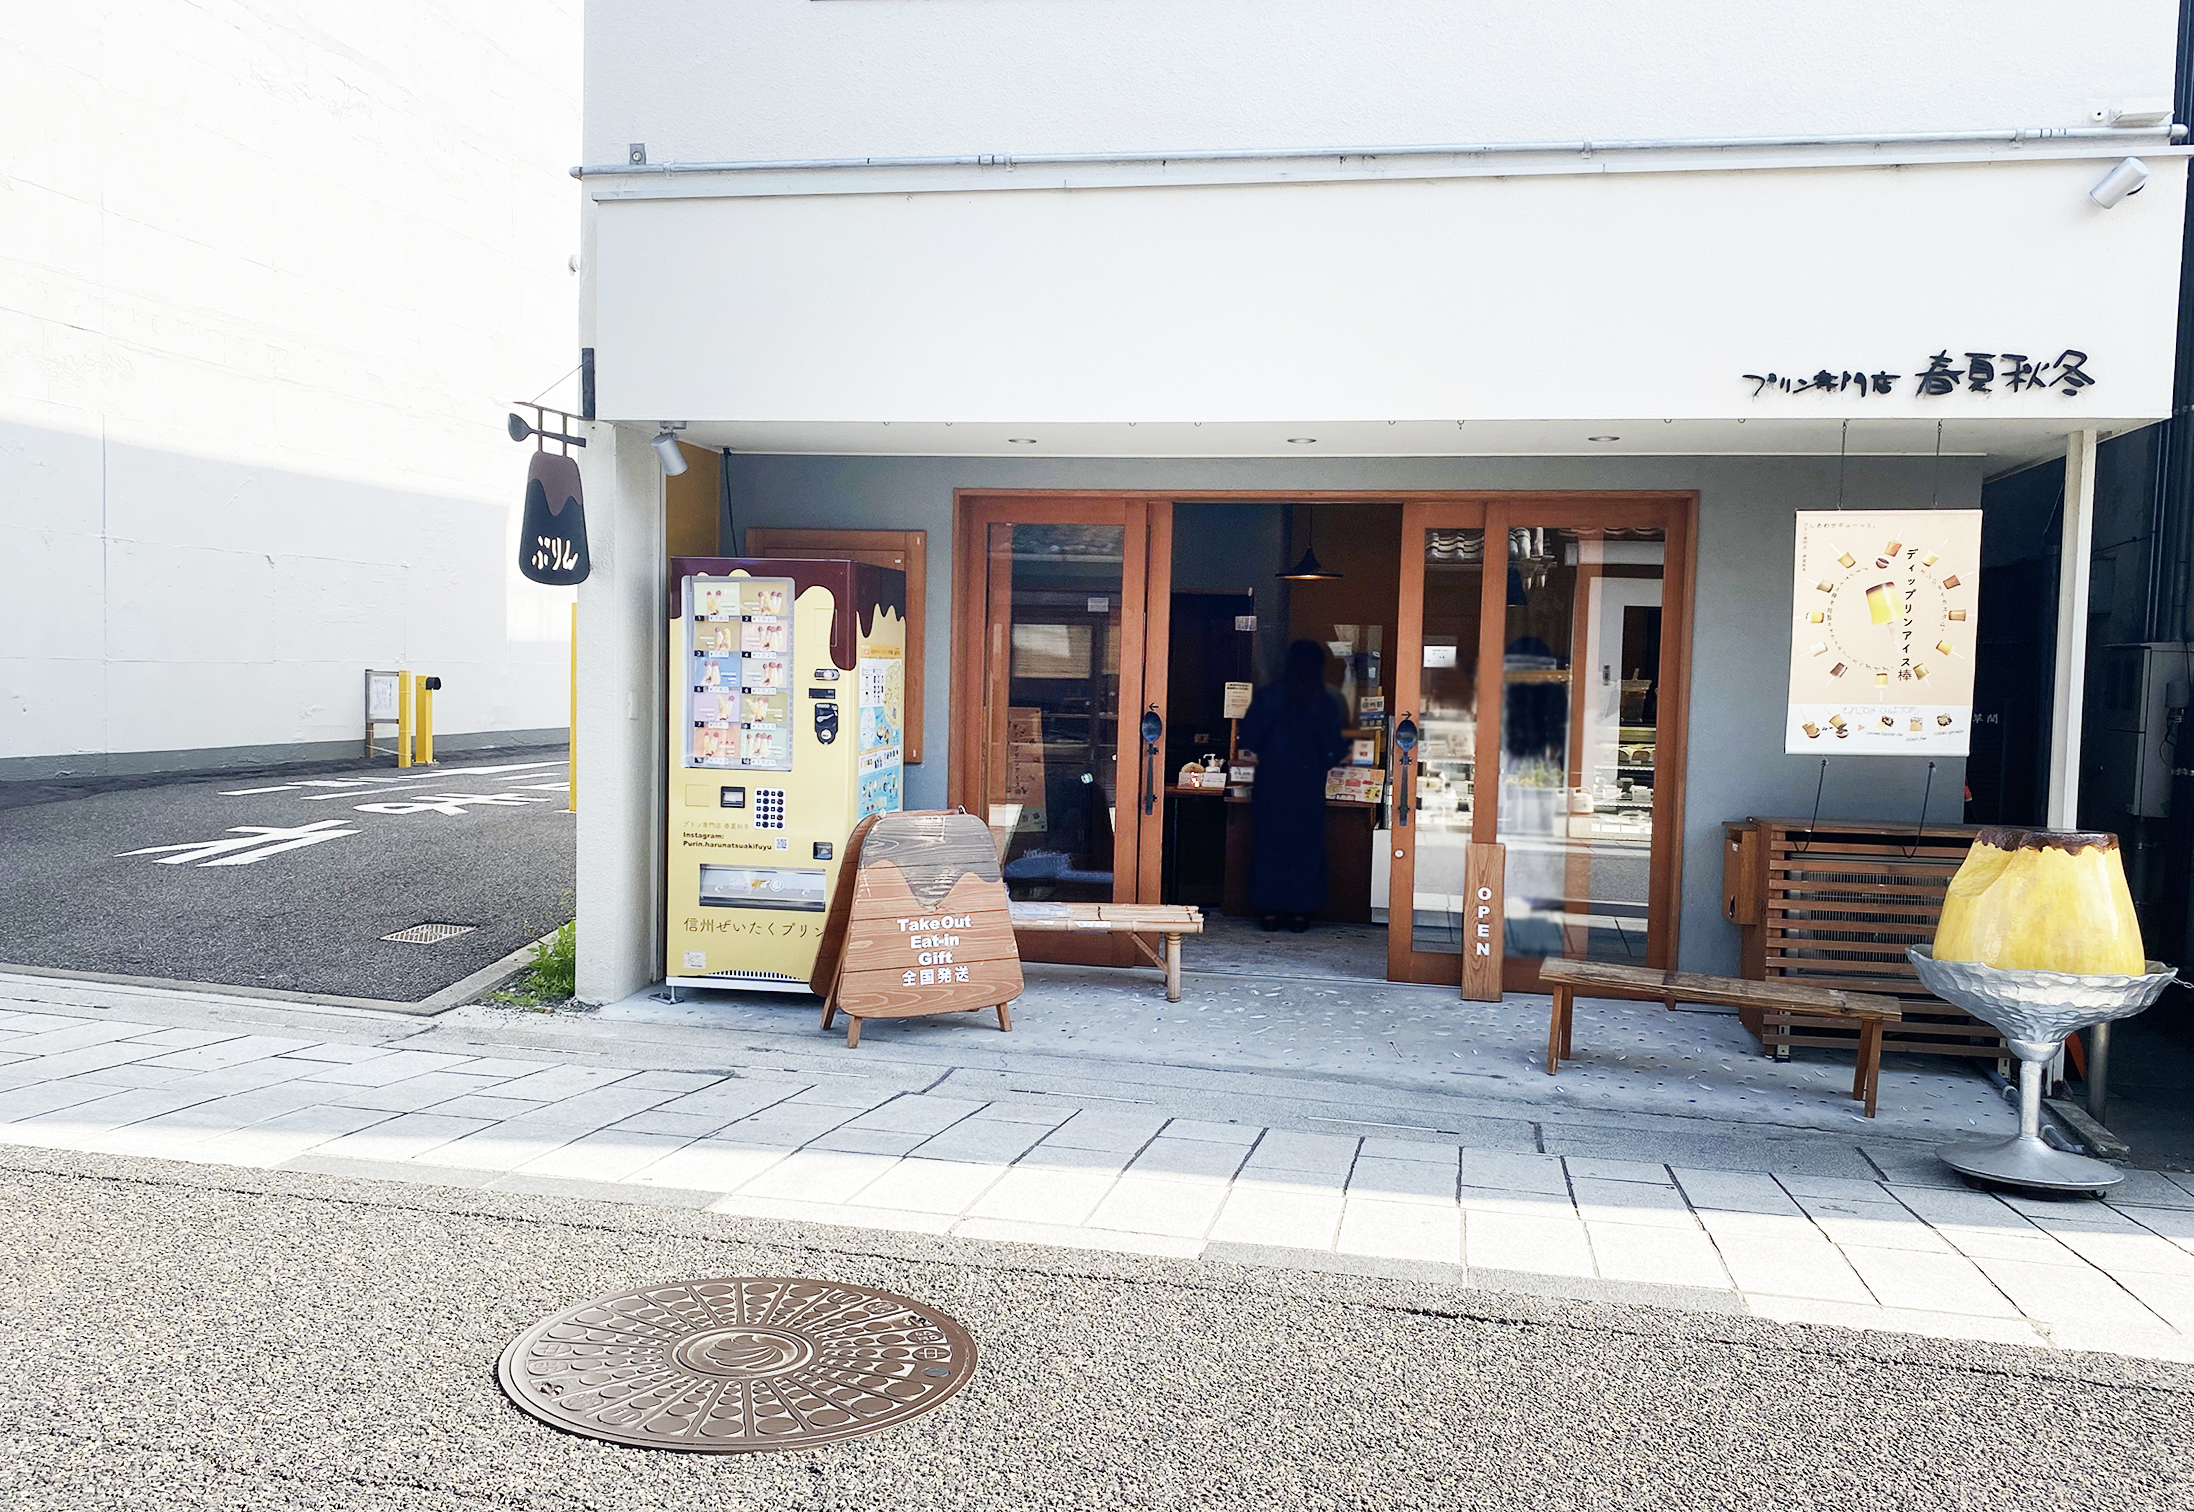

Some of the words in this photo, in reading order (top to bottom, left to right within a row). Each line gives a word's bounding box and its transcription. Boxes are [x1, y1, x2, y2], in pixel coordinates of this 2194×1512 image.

[1742, 369, 1902, 398] プリン専門店
[1914, 348, 2096, 397] 春夏秋冬
[531, 535, 579, 571] ぷりん
[1897, 547, 1919, 682] ディップリンアイス棒
[683, 831, 725, 840] Instagram:
[683, 840, 772, 851] Purin.harunatsuakifuyu
[683, 917, 824, 938] 信州ぜいたくプリン
[1476, 886, 1492, 956] OPEN
[910, 933, 960, 949] Eat-in
[917, 951, 954, 966] Gift
[901, 965, 970, 987] 全国発送
